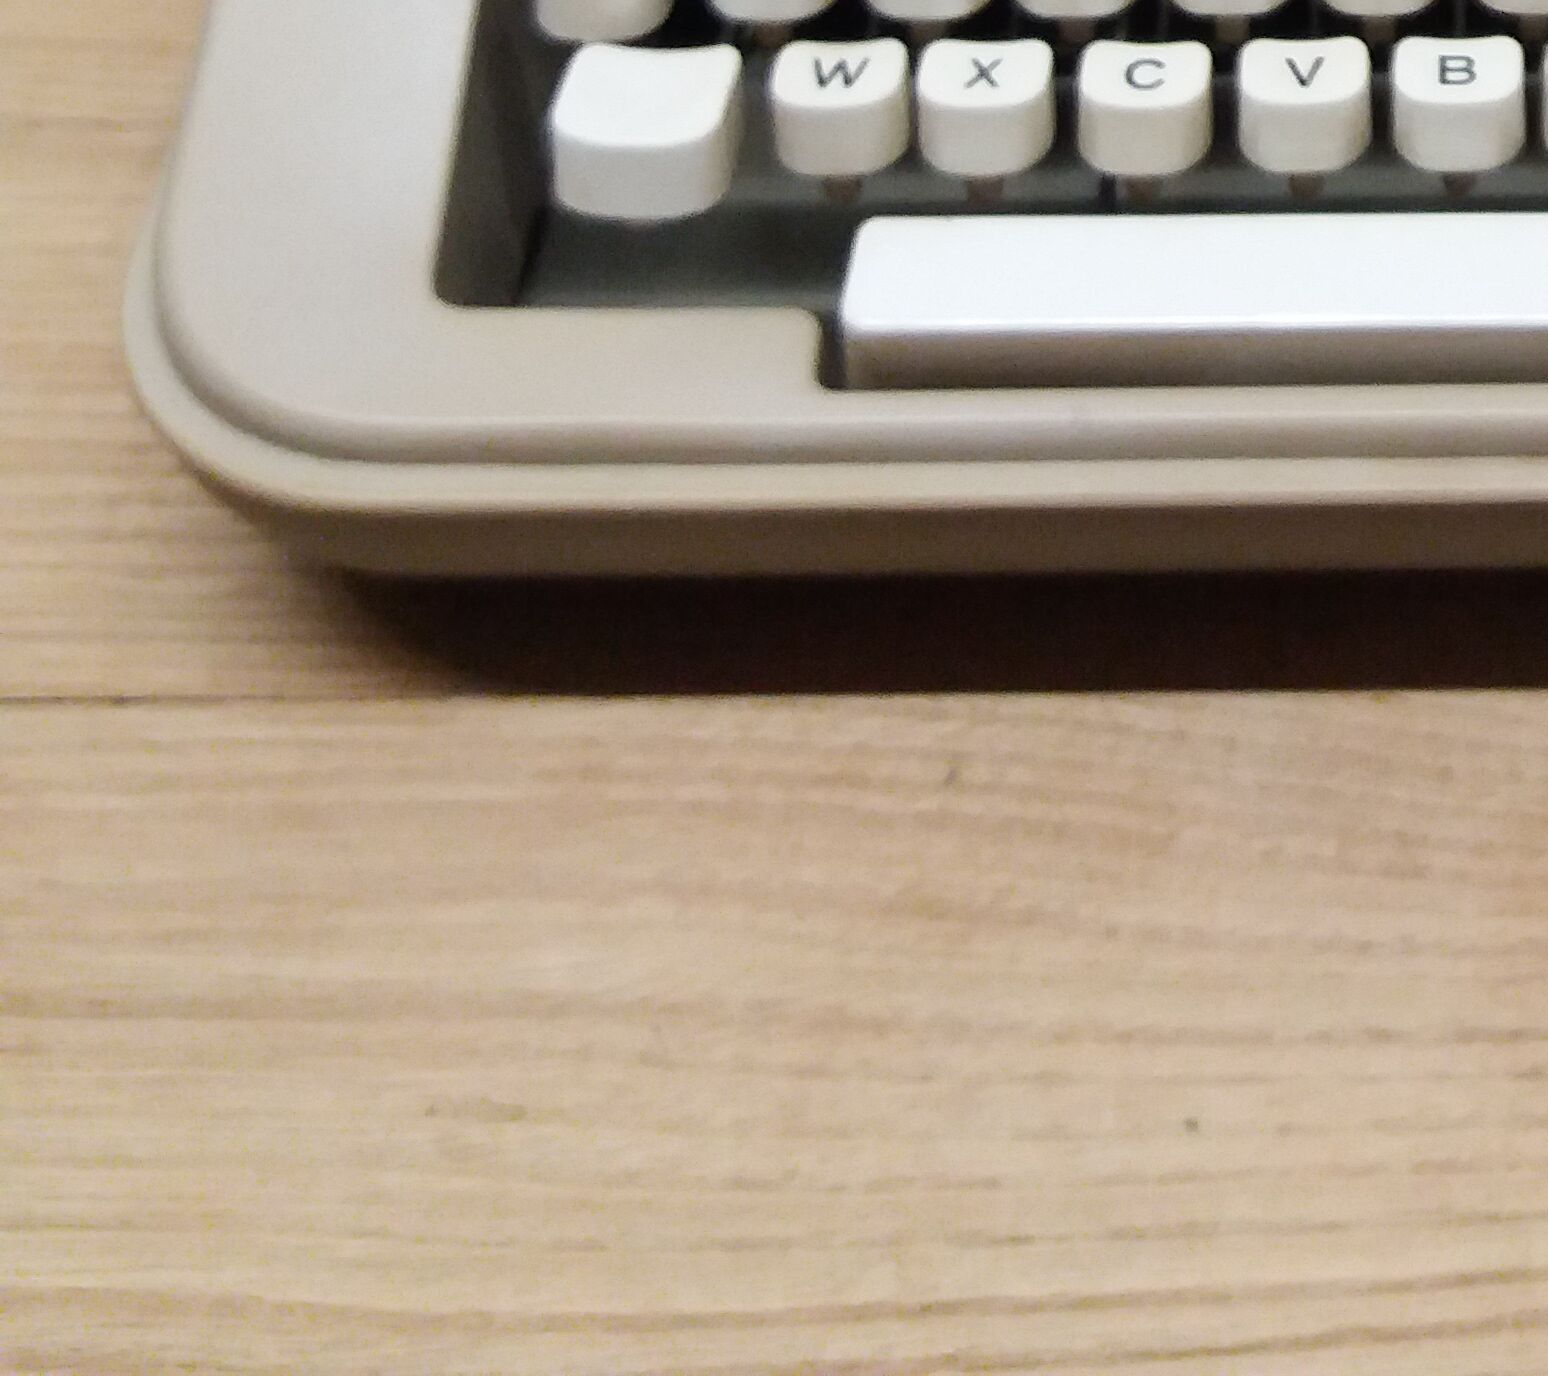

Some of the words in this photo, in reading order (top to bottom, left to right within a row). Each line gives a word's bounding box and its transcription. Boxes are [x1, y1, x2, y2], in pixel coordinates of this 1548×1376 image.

[812, 56, 871, 90] W
[964, 57, 1004, 89] X
[1124, 57, 1166, 91] C
[1284, 54, 1325, 89] V
[1437, 54, 1478, 86] B
